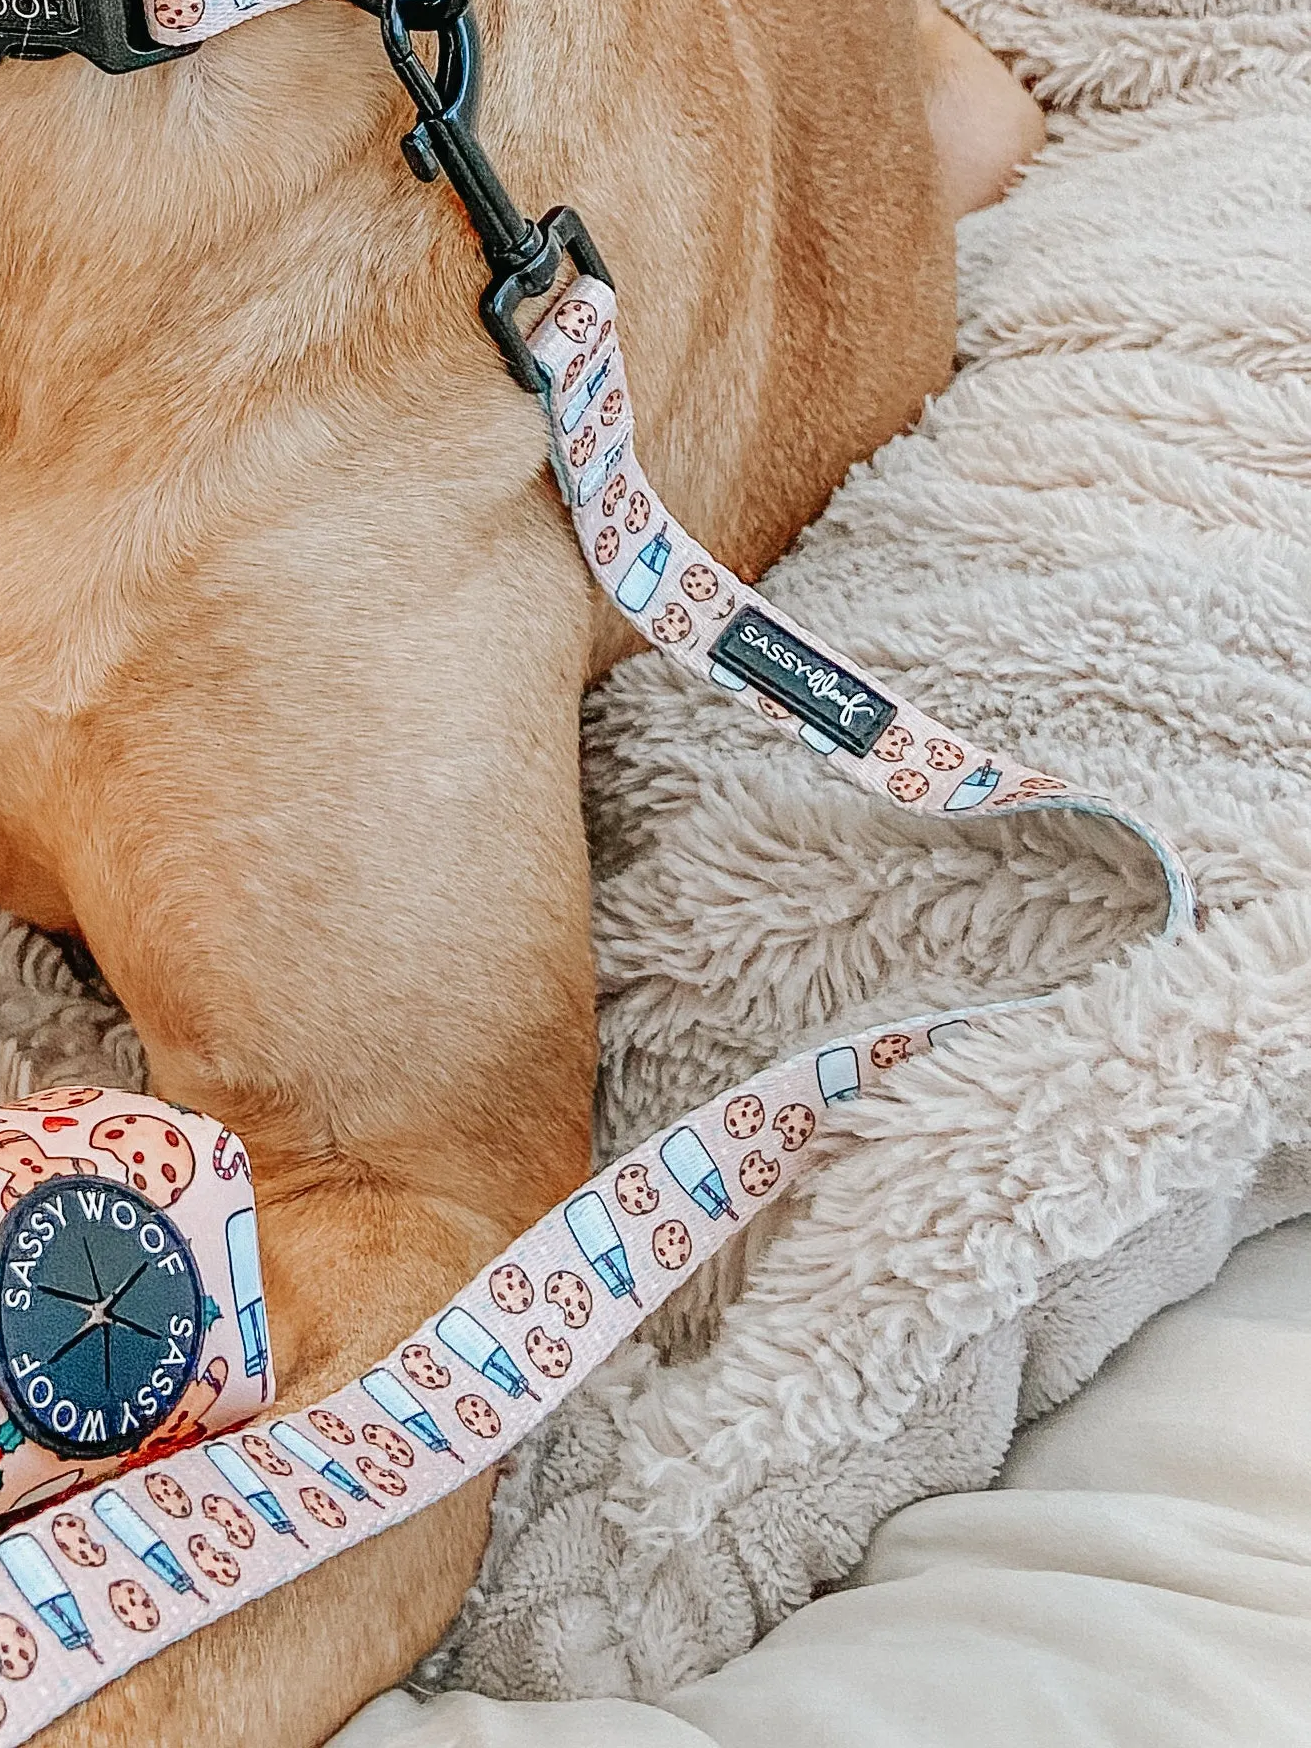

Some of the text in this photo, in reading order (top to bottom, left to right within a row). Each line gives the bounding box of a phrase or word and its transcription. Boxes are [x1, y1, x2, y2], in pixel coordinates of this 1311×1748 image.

[739, 625, 875, 727] SASSY Woof
[4, 1190, 185, 1311] SASSY WOOF
[11, 1314, 194, 1442] SASSY WOOF
